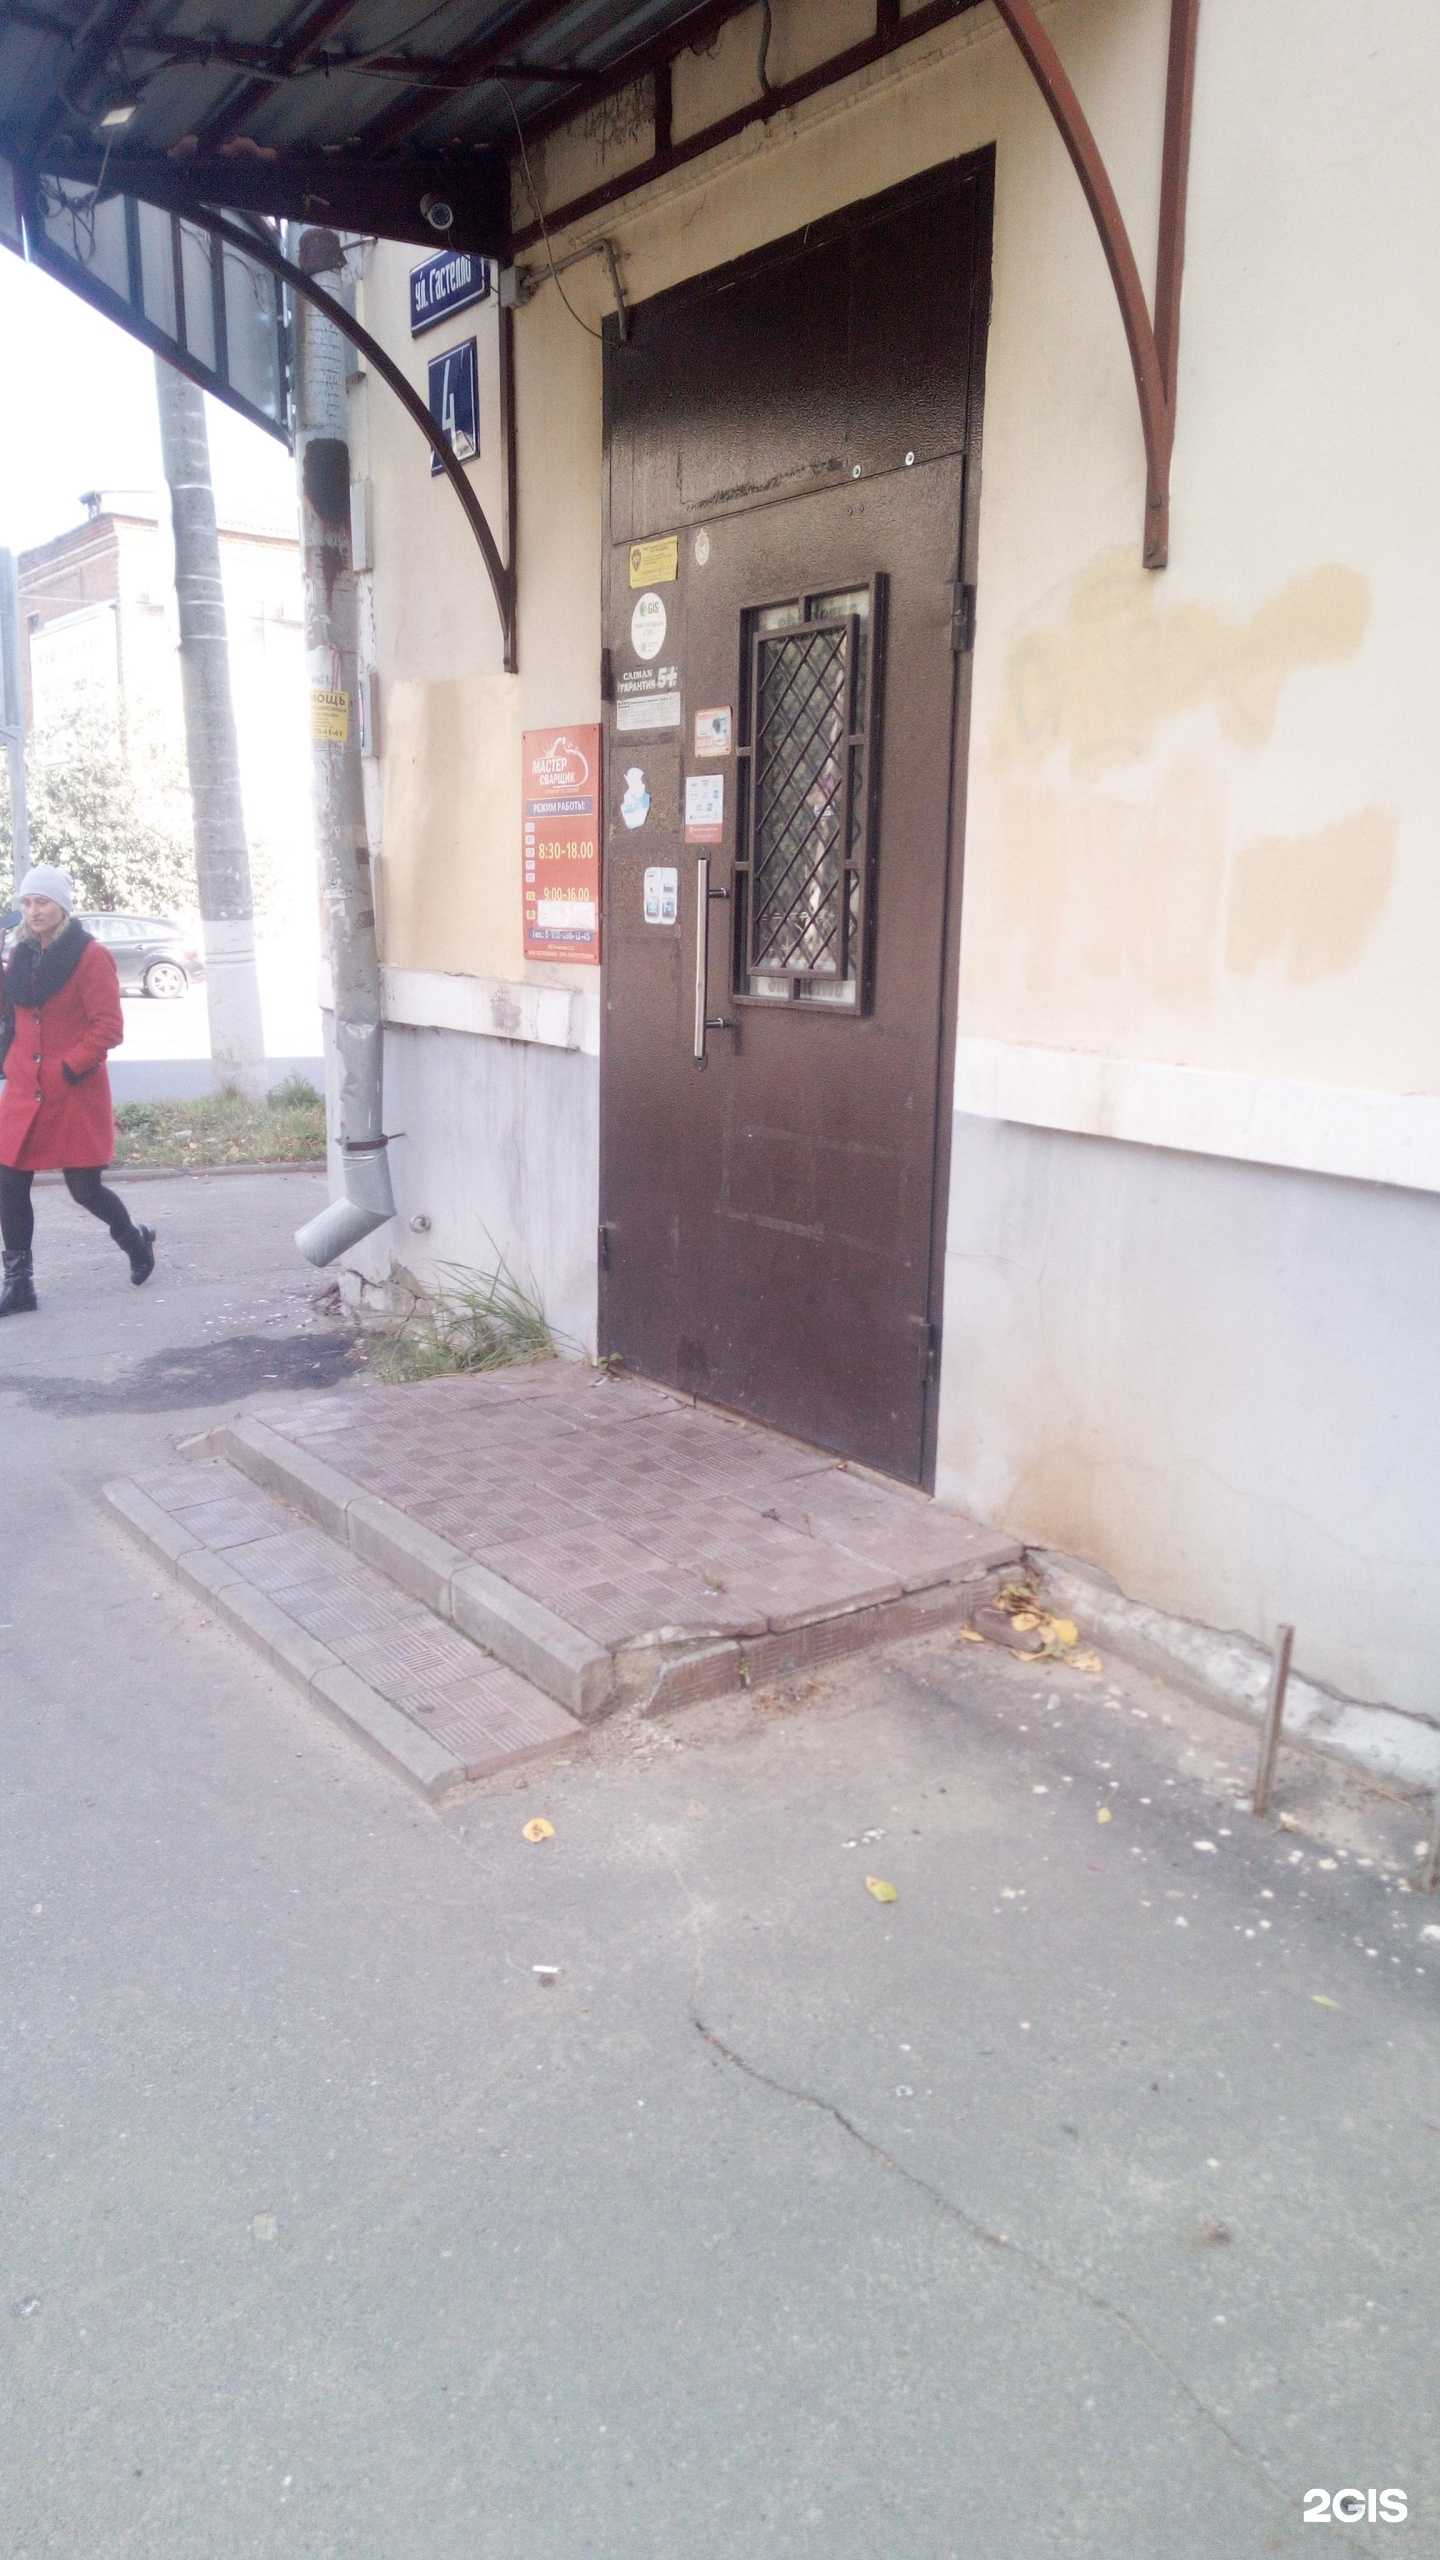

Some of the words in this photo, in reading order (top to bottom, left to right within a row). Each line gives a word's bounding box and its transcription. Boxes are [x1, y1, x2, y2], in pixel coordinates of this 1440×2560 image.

[415, 276, 429, 312] ул.
[429, 255, 472, 304] Гастелло
[442, 359, 457, 452] 4
[532, 757, 568, 775] МАСТЕР
[539, 771, 576, 785] СВАРЩИК
[533, 802, 557, 815] РЕЖИМ
[538, 841, 594, 859] 8:30-18.00
